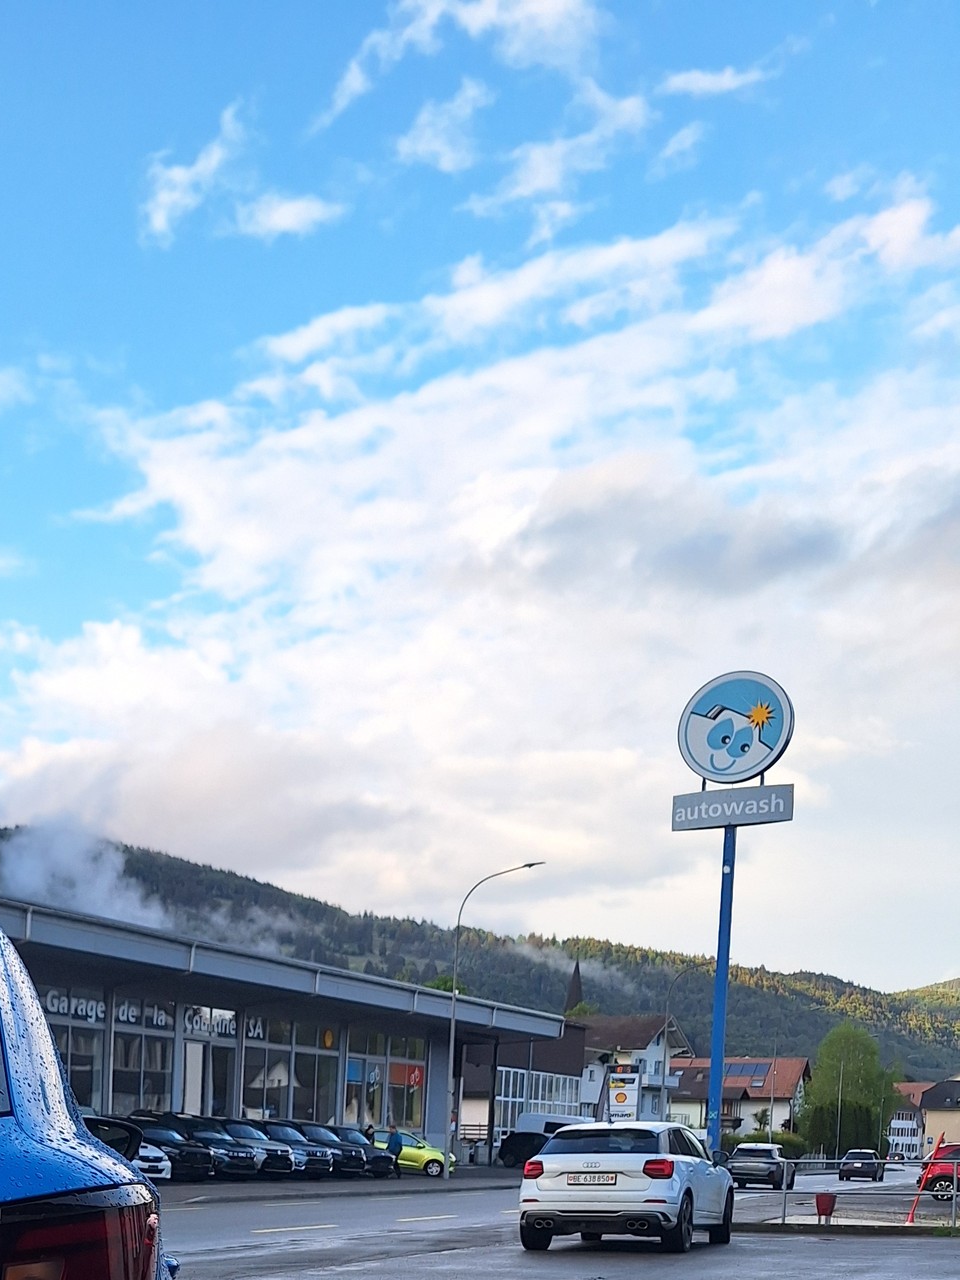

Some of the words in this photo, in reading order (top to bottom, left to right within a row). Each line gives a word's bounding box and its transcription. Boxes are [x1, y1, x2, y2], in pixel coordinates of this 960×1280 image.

[675, 793, 784, 822] autowash
[46, 990, 106, 1024] Garage
[118, 1000, 137, 1023] de
[153, 1005, 166, 1026] la
[248, 1016, 264, 1039] SA
